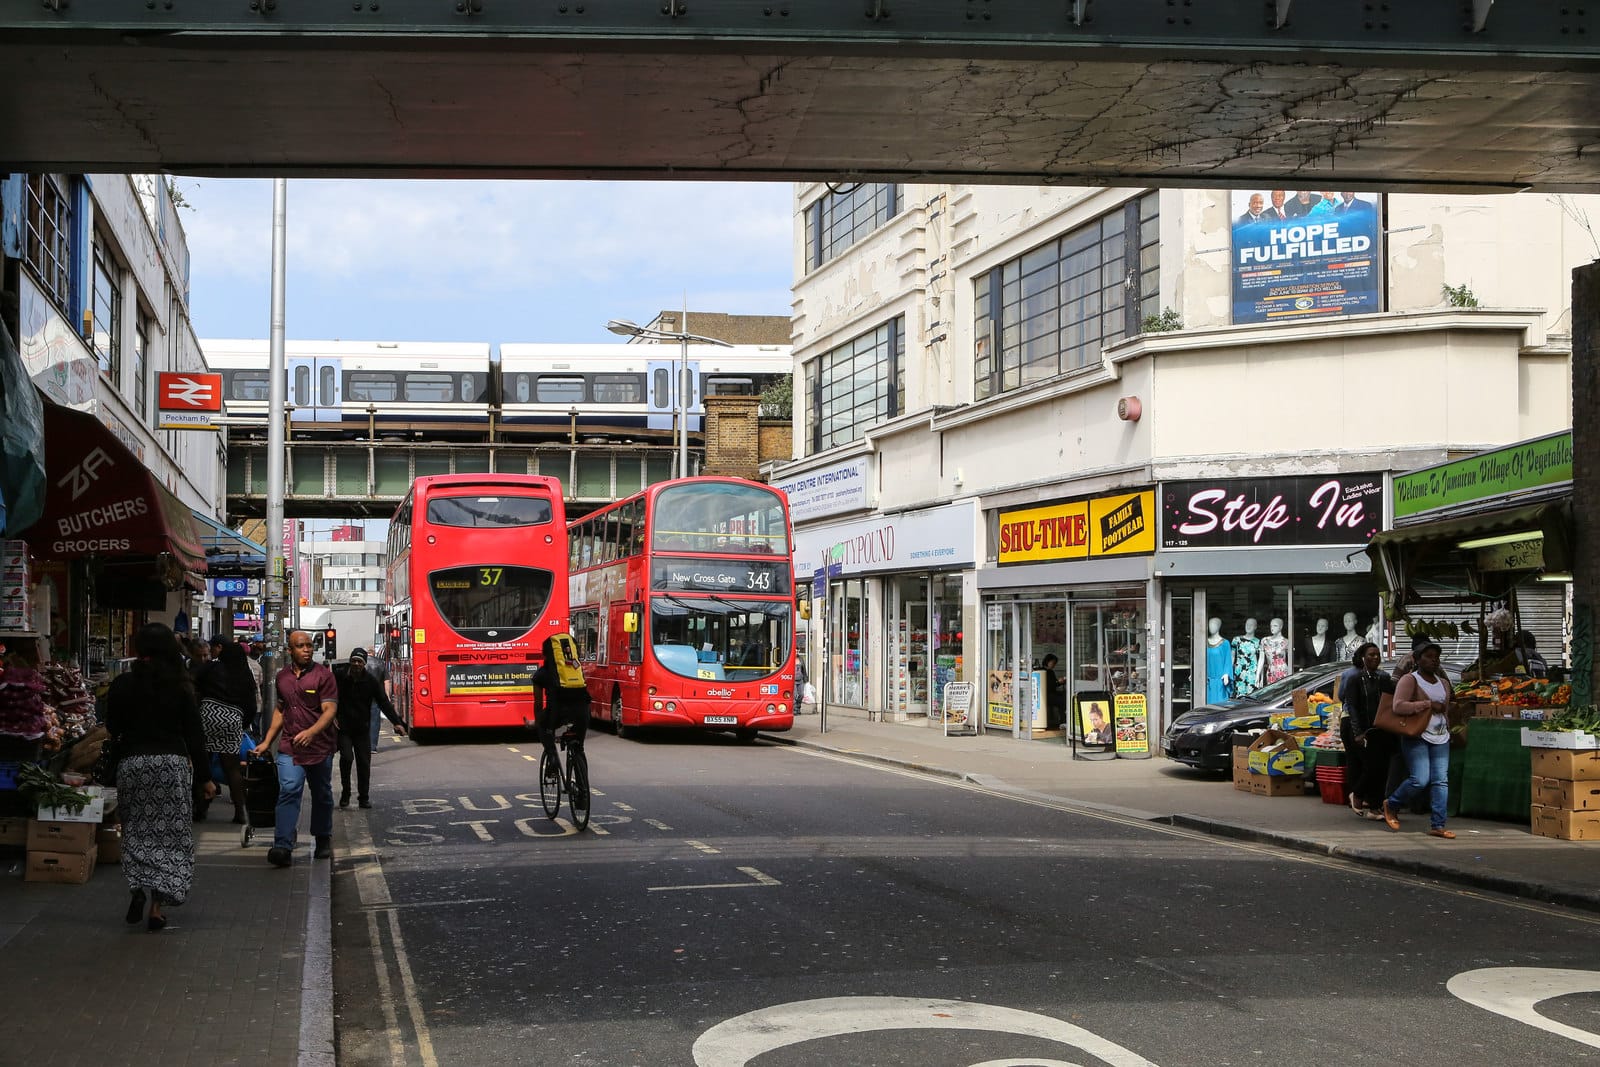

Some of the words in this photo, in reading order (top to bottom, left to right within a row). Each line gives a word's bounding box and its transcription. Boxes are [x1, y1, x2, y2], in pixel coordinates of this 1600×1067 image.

[1270, 222, 1340, 245] HOPE
[1240, 236, 1370, 264] FULFILLED
[797, 478, 816, 491] CENTRE
[817, 467, 859, 487] INTERNATIONAL
[1398, 480, 1428, 502] Welcome
[1430, 473, 1440, 495] To
[1442, 468, 1476, 497] Jamaican
[1480, 457, 1510, 484] Village
[1512, 450, 1524, 480] Of
[1526, 440, 1572, 475] Vegetables
[1342, 490, 1362, 501] Ladies
[1363, 486, 1382, 496] Wear
[1344, 482, 1374, 494] Exclusive
[58, 497, 148, 536] BUTCHERS
[1108, 503, 1133, 529] FAMILY
[1179, 488, 1290, 543] Step
[1309, 480, 1364, 529] In
[53, 538, 130, 552] GROCERS
[1000, 514, 1087, 553] SHU-TIME
[1103, 516, 1144, 550] FOOTWEAR
[480, 568, 503, 586] 37
[673, 573, 690, 582] New
[694, 574, 714, 583] Cross
[718, 574, 736, 584] Gate
[747, 572, 769, 589] 343
[707, 688, 732, 696] abellio
[400, 792, 569, 815] BUS
[385, 814, 632, 846] STOP
